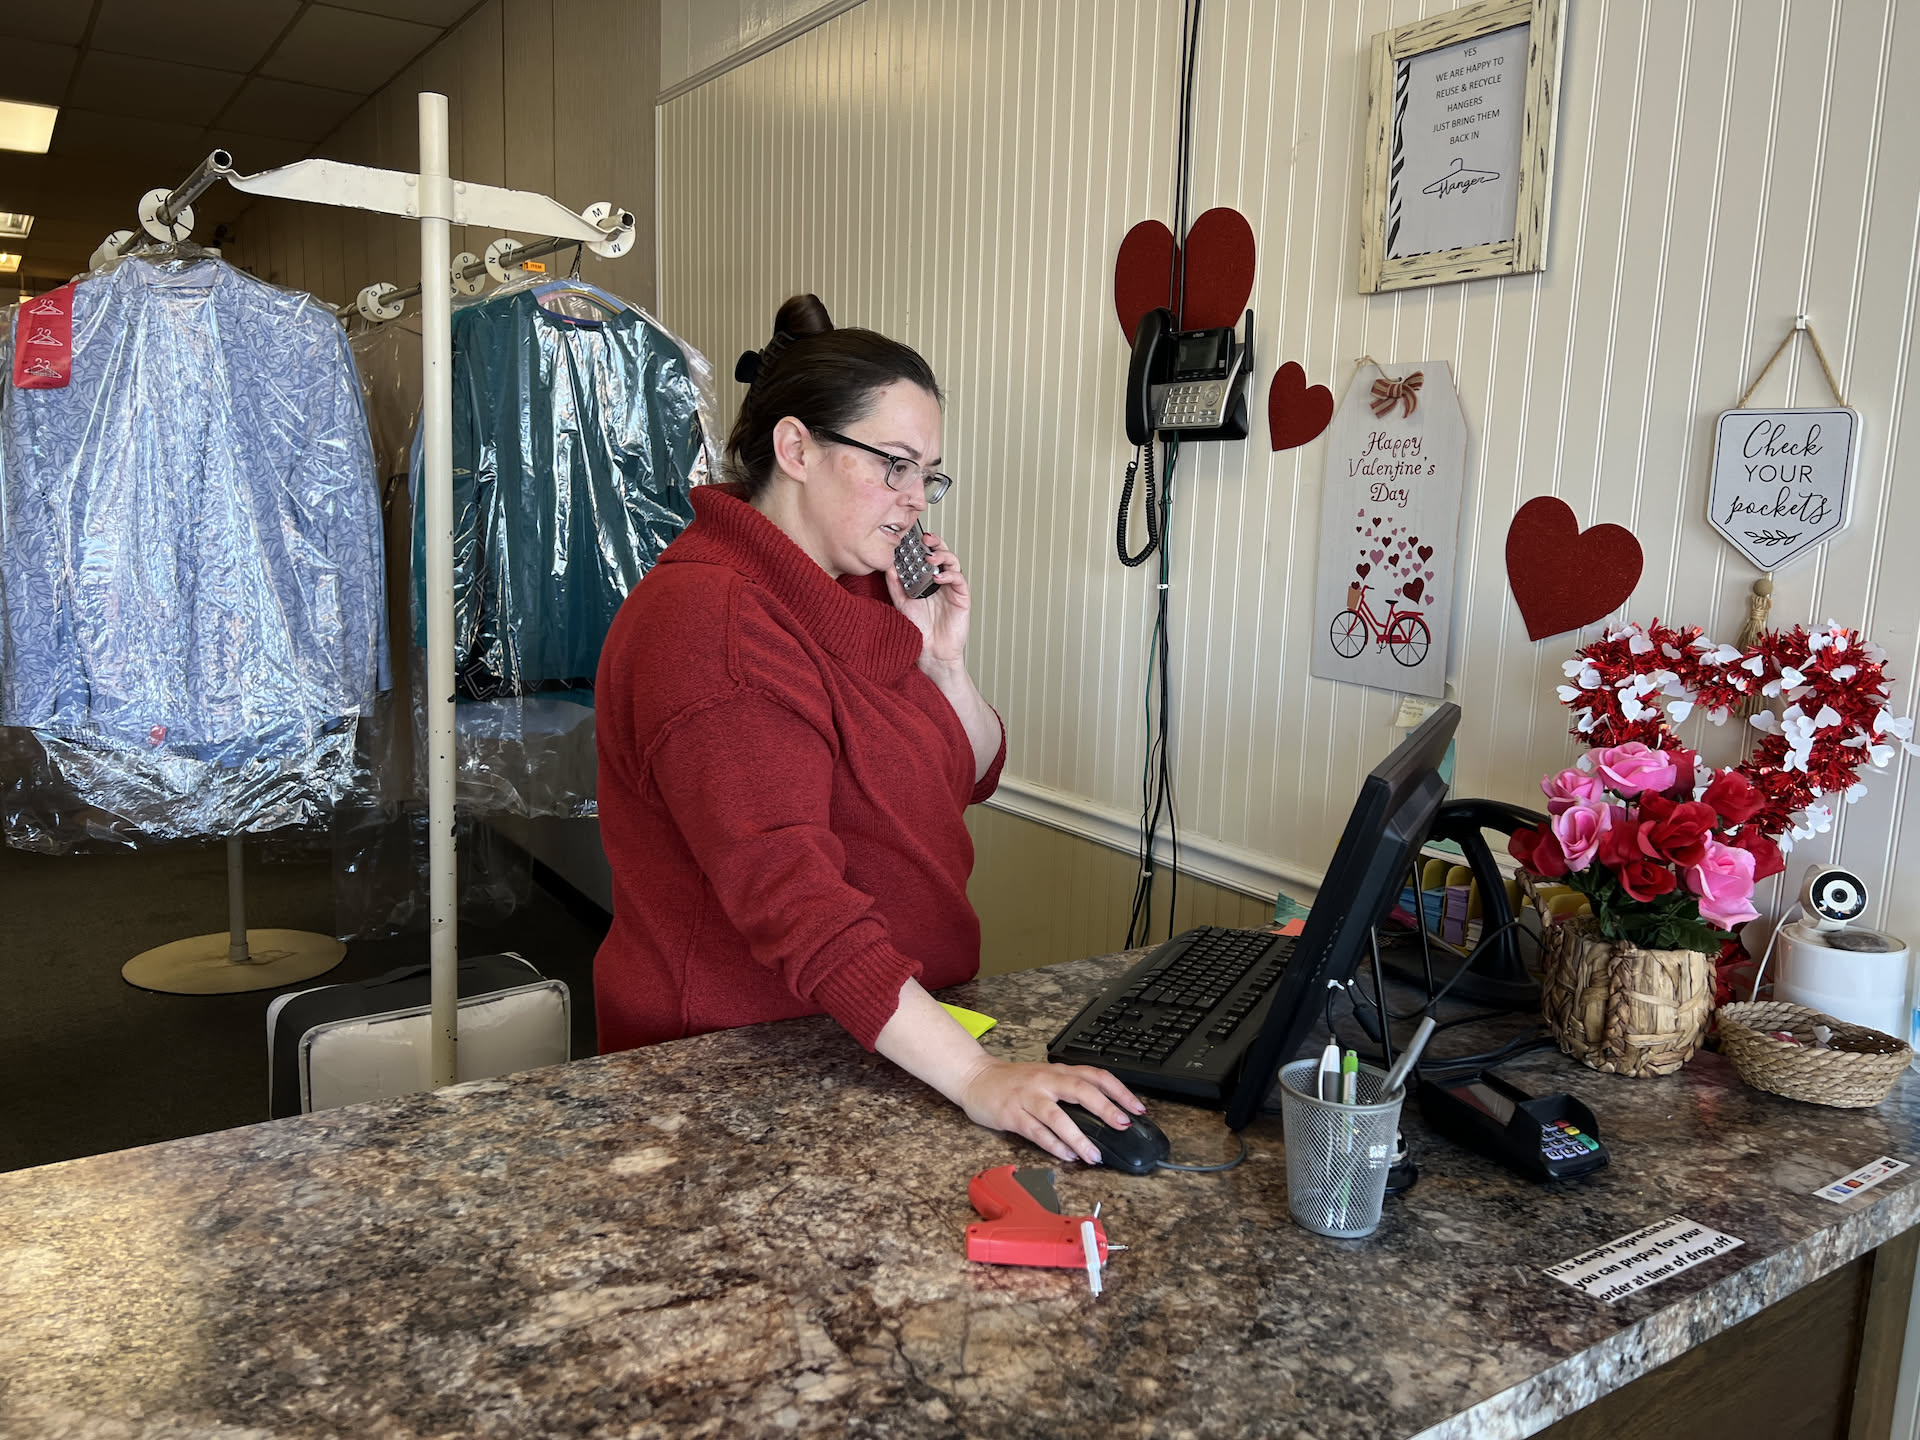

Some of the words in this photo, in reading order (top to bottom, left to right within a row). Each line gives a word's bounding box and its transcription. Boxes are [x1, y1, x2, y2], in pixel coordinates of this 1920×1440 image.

[1464, 47, 1477, 57] YES
[1436, 72, 1448, 82] WE
[1450, 67, 1464, 78] ARE
[1466, 60, 1491, 74] HAPPY
[1493, 56, 1504, 66] TO
[1436, 85, 1459, 99] REUSE
[1461, 83, 1467, 92] &
[1469, 74, 1502, 90] RECYCLE
[1447, 96, 1483, 112] HANGERS
[1432, 121, 1450, 133] JUST
[1452, 115, 1475, 128] BRING
[1477, 109, 1500, 121] THEM
[1449, 133, 1470, 145] BACK
[1471, 130, 1480, 140] IN
[1439, 177, 1485, 199] Hanger
[592, 208, 602, 217] M
[1362, 431, 1423, 458] Happy
[1743, 419, 1823, 459] Check
[1348, 457, 1436, 482] Valentine's
[1744, 464, 1813, 483] YOUR
[1370, 482, 1410, 508] Day
[1724, 486, 1832, 525] pockets
[1562, 1261, 1575, 1272] is
[1573, 1245, 1616, 1267] deeply
[1612, 1219, 1676, 1248] appreciated
[1573, 1273, 1601, 1291] you
[1598, 1263, 1622, 1276] can
[1619, 1246, 1663, 1268] prepay
[1655, 1237, 1677, 1250] for
[1675, 1227, 1704, 1243] your
[1599, 1281, 1635, 1302] order
[1632, 1274, 1649, 1287] at
[1644, 1263, 1675, 1281] time
[1673, 1254, 1689, 1268] of
[1686, 1245, 1717, 1261] drop
[1713, 1234, 1734, 1249] off
